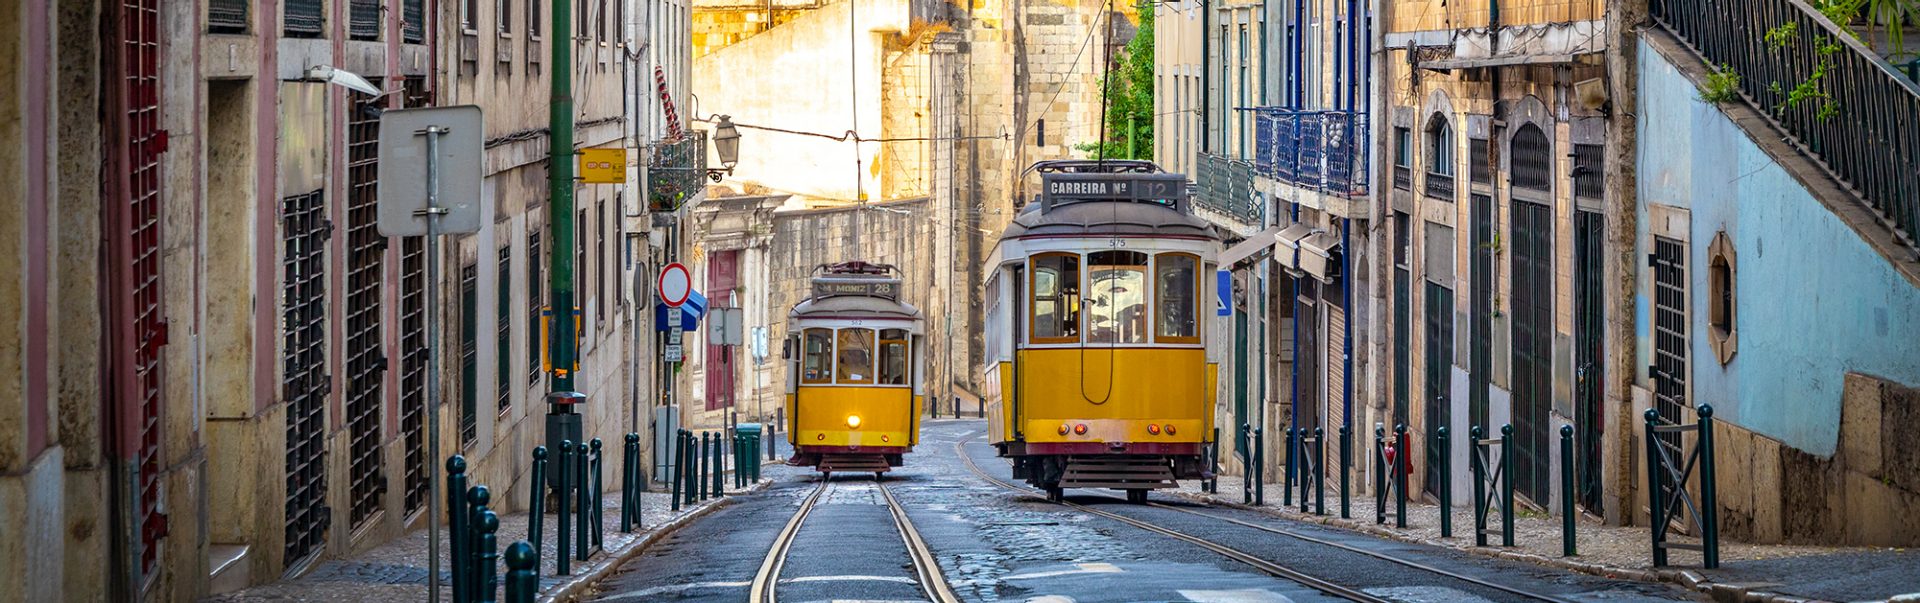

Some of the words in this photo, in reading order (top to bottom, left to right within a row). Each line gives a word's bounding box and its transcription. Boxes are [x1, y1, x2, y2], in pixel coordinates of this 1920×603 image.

[1050, 182, 1106, 194] CARREIRA
[1148, 183, 1166, 196] 12
[1109, 239, 1125, 247] 575
[874, 283, 890, 293] 28
